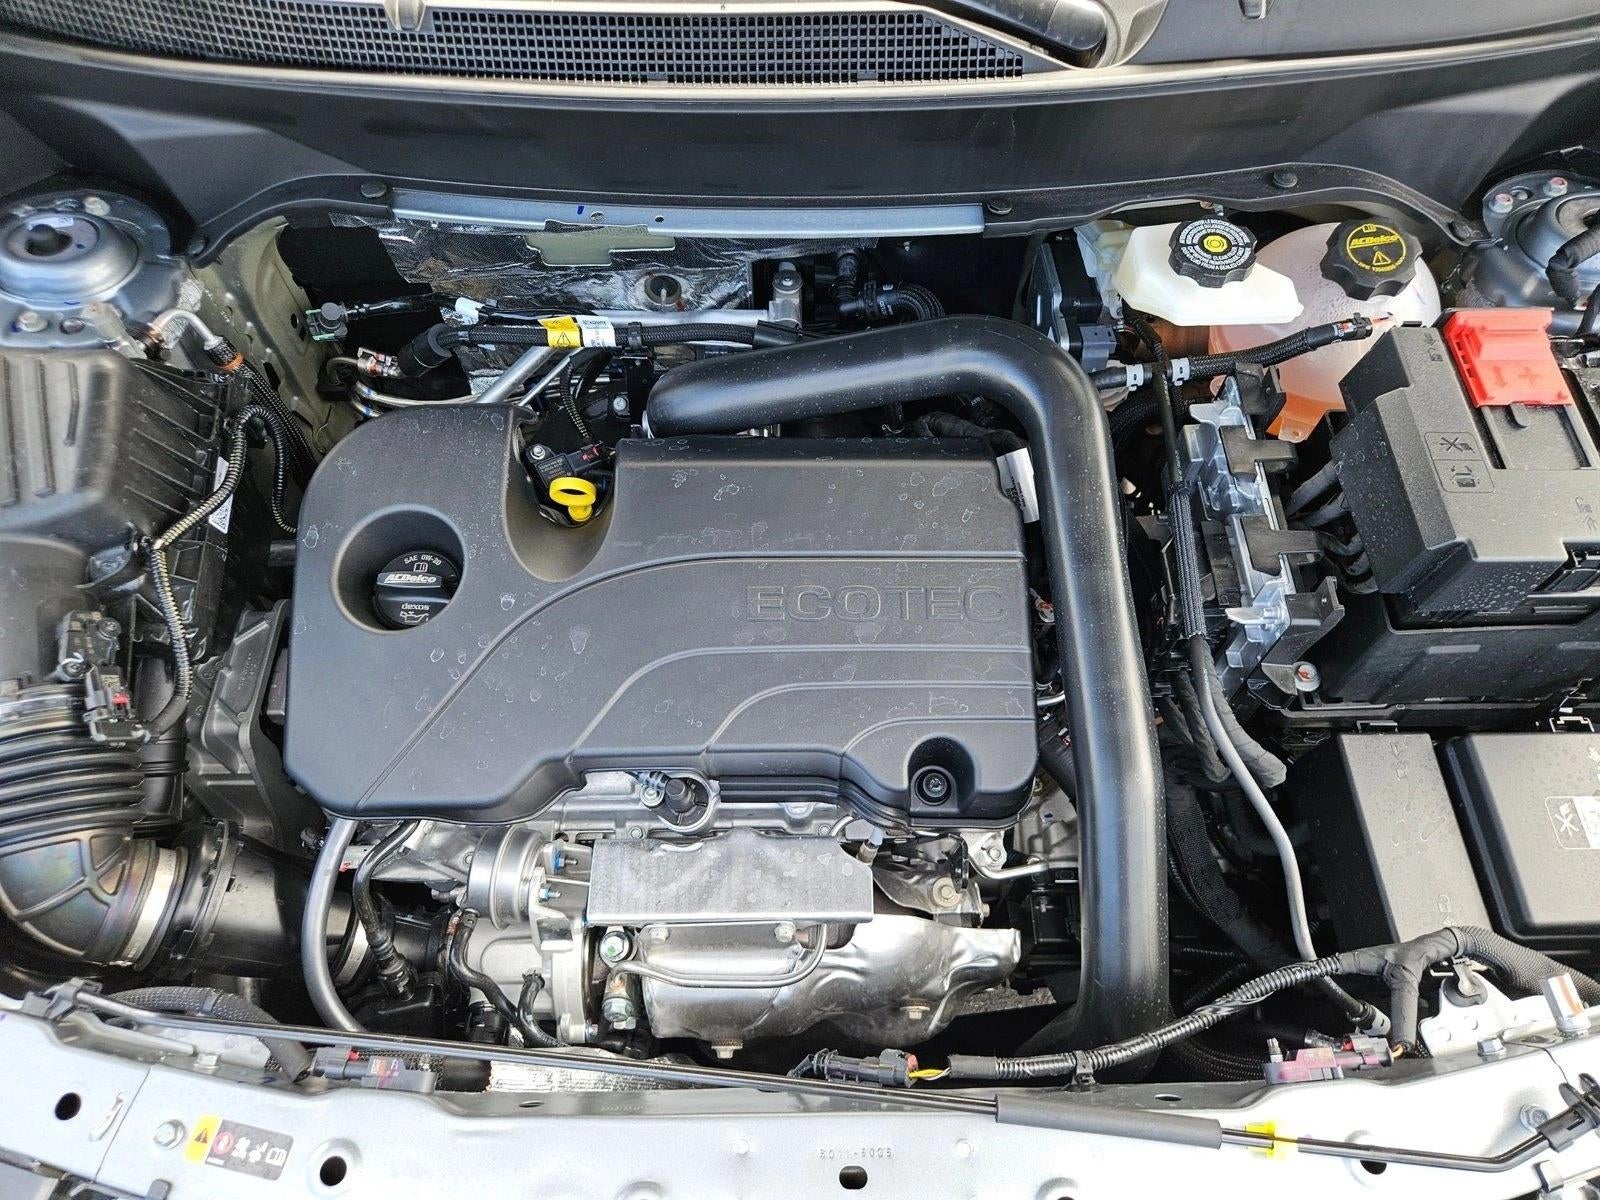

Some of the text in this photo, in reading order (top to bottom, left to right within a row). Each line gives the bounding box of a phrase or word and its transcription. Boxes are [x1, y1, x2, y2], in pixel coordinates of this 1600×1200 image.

[1350, 234, 1399, 246] ACDelco
[404, 554, 442, 566] SAE 0W-20
[383, 573, 437, 584] ACDelco
[401, 602, 430, 611] dexos
[747, 584, 1008, 623] ECOTEC
